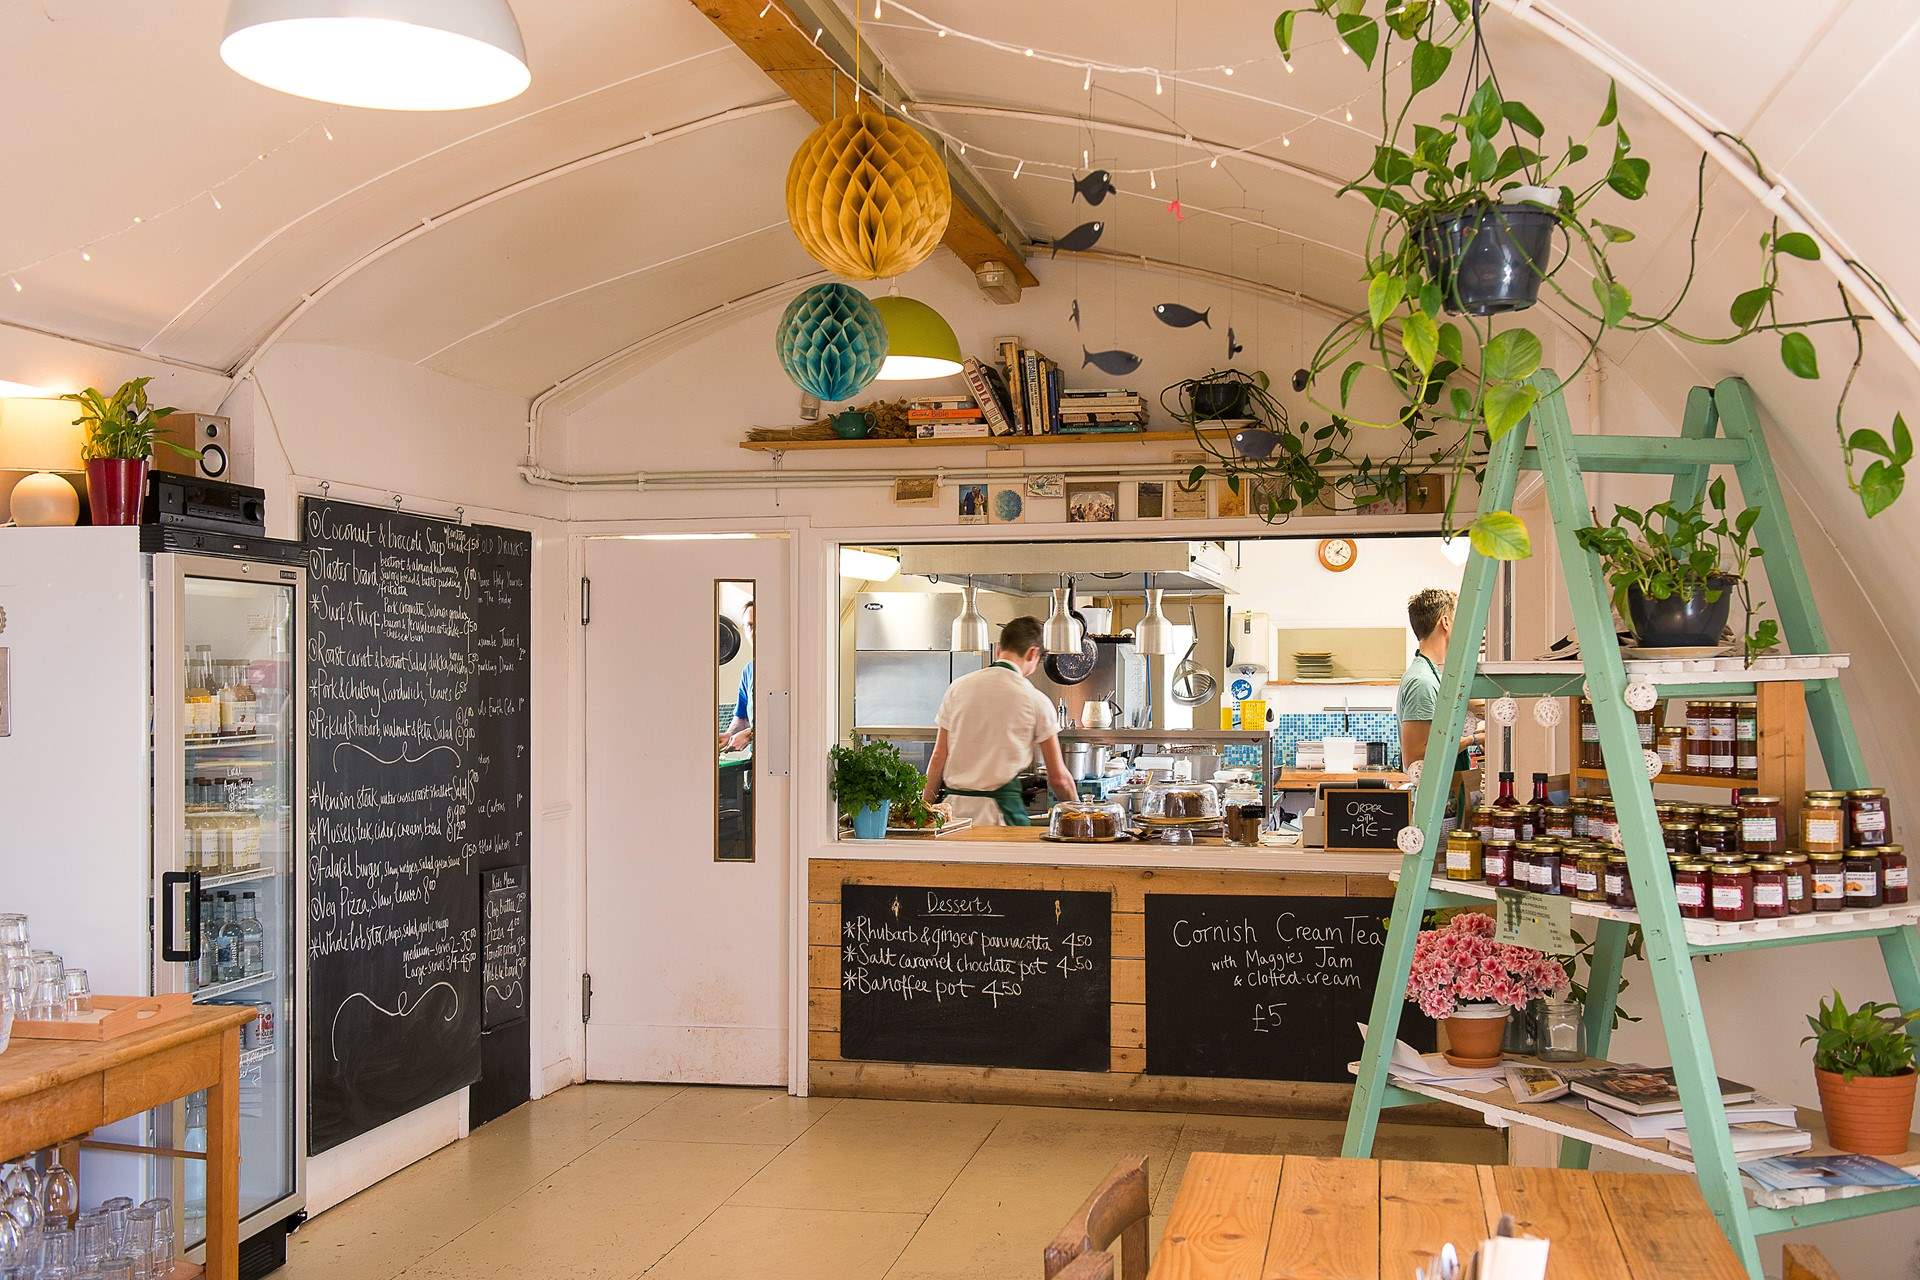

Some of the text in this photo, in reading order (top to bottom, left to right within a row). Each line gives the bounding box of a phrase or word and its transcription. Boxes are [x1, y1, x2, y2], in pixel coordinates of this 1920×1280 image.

[968, 369, 991, 408] INDIA
[322, 507, 376, 547] Coconut
[379, 523, 385, 547] &
[318, 547, 351, 581] Taster
[319, 585, 346, 631] Surf
[347, 600, 354, 626] &
[318, 631, 345, 668] Roast
[318, 668, 339, 705] Pork
[317, 780, 355, 812] Venison
[1346, 801, 1393, 816] ORDER
[318, 891, 336, 935] Veg
[928, 892, 992, 913] Desserts
[857, 916, 918, 943] Rhubarb
[922, 926, 931, 946] &
[932, 923, 977, 957] ginger
[981, 935, 1053, 956] pannacotta
[1173, 912, 1385, 948] Cornish Cream Tea
[857, 943, 897, 965] Salt
[899, 952, 953, 973] caramel
[956, 953, 1017, 975] chocolate
[1020, 960, 1048, 981] pot
[1211, 956, 1237, 971] with
[1315, 946, 1353, 968] Jam
[857, 967, 931, 1000] Banoffee
[936, 978, 975, 1003] pot
[1234, 975, 1242, 987] &
[1306, 972, 1361, 989] cream
[1252, 1002, 1287, 1033] £5
